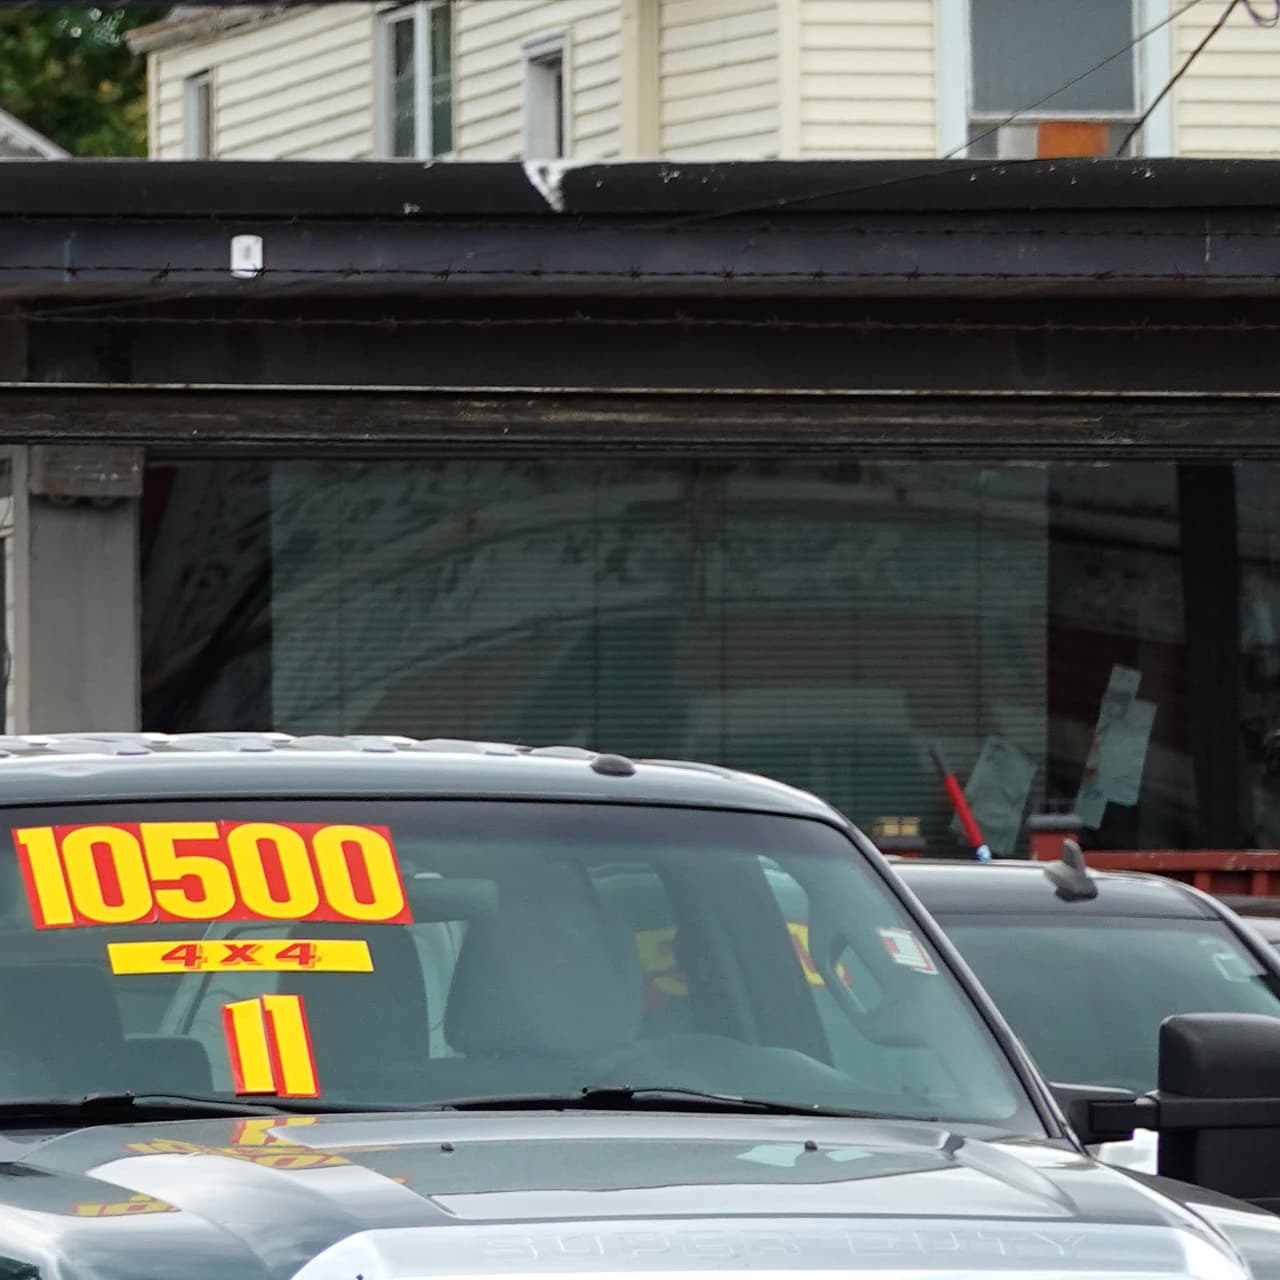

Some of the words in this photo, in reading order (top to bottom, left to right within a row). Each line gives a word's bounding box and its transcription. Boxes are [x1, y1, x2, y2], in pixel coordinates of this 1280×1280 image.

[16, 822, 405, 926] 10500
[225, 994, 316, 1095] 11
[479, 1230, 801, 1260] SUPER
[843, 1230, 1087, 1258] DUTY
